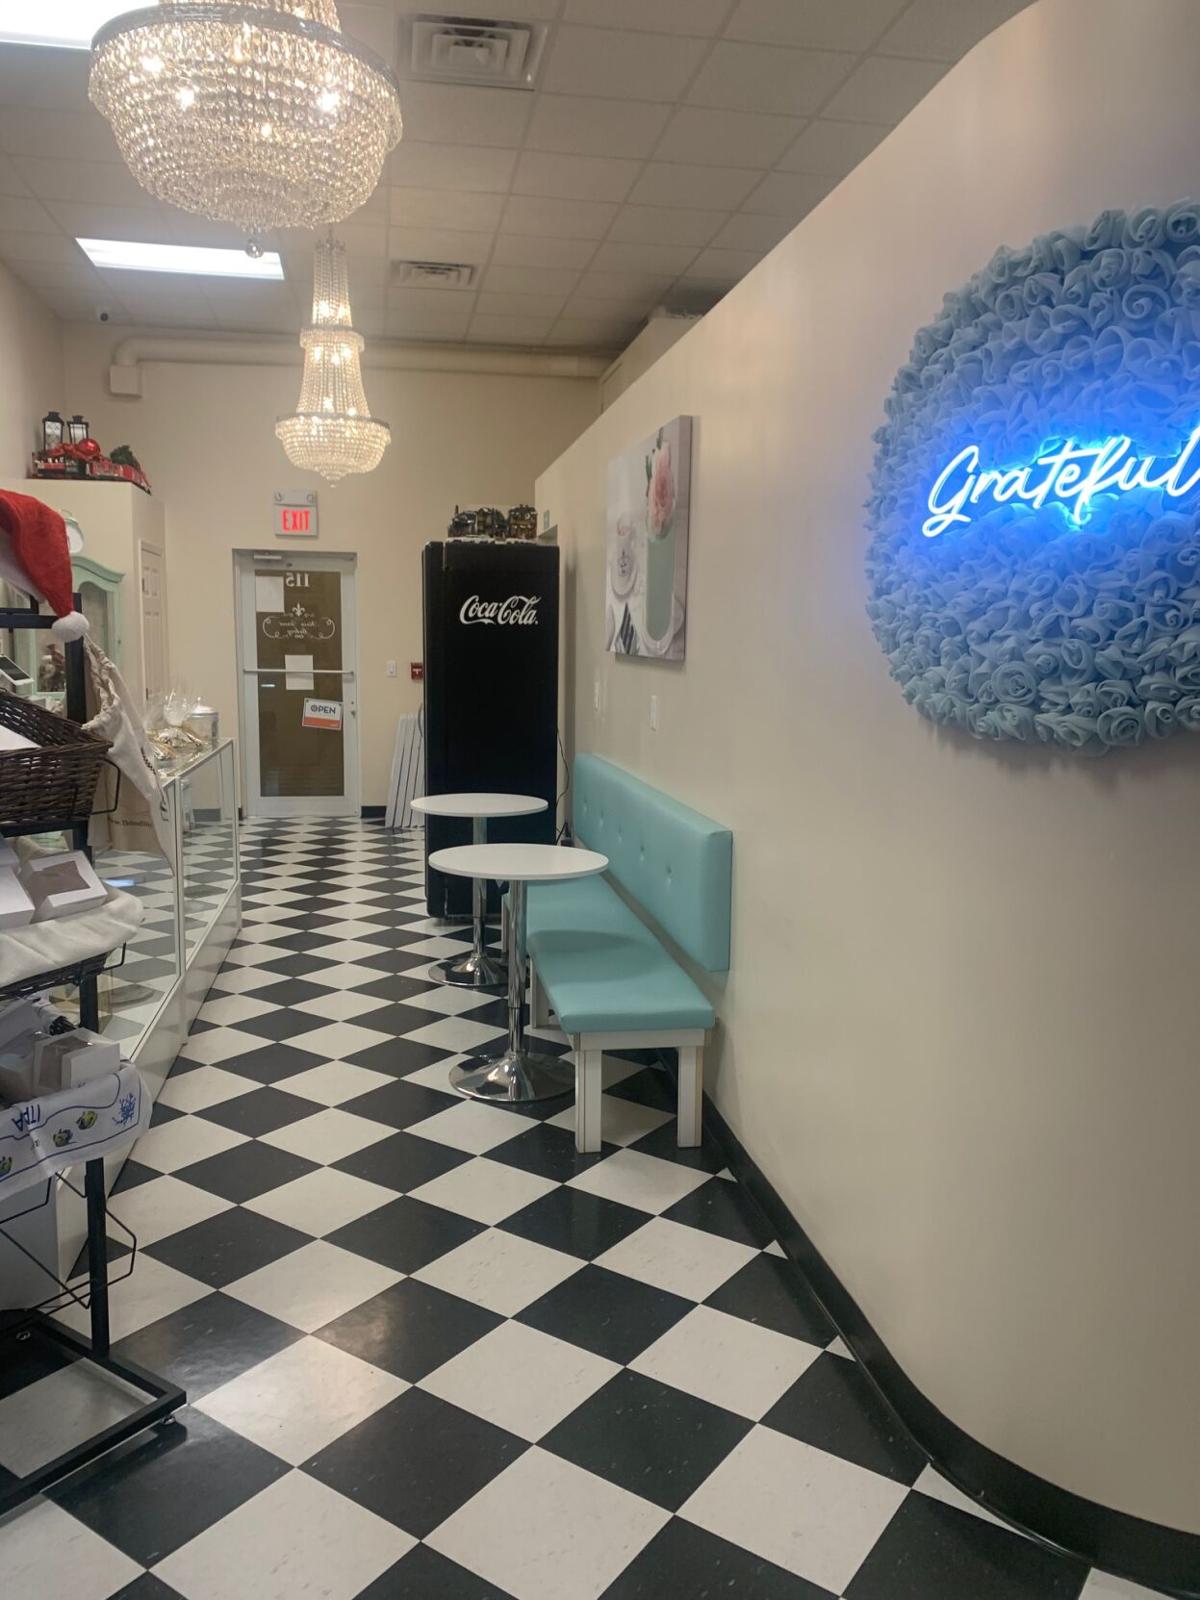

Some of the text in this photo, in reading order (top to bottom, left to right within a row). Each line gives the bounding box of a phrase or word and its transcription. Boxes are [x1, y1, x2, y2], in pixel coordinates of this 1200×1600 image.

[922, 421, 1200, 538] Grateful
[282, 509, 311, 531] EXIT
[460, 595, 542, 625] Coca-Cola
[310, 704, 336, 715] OPEN
